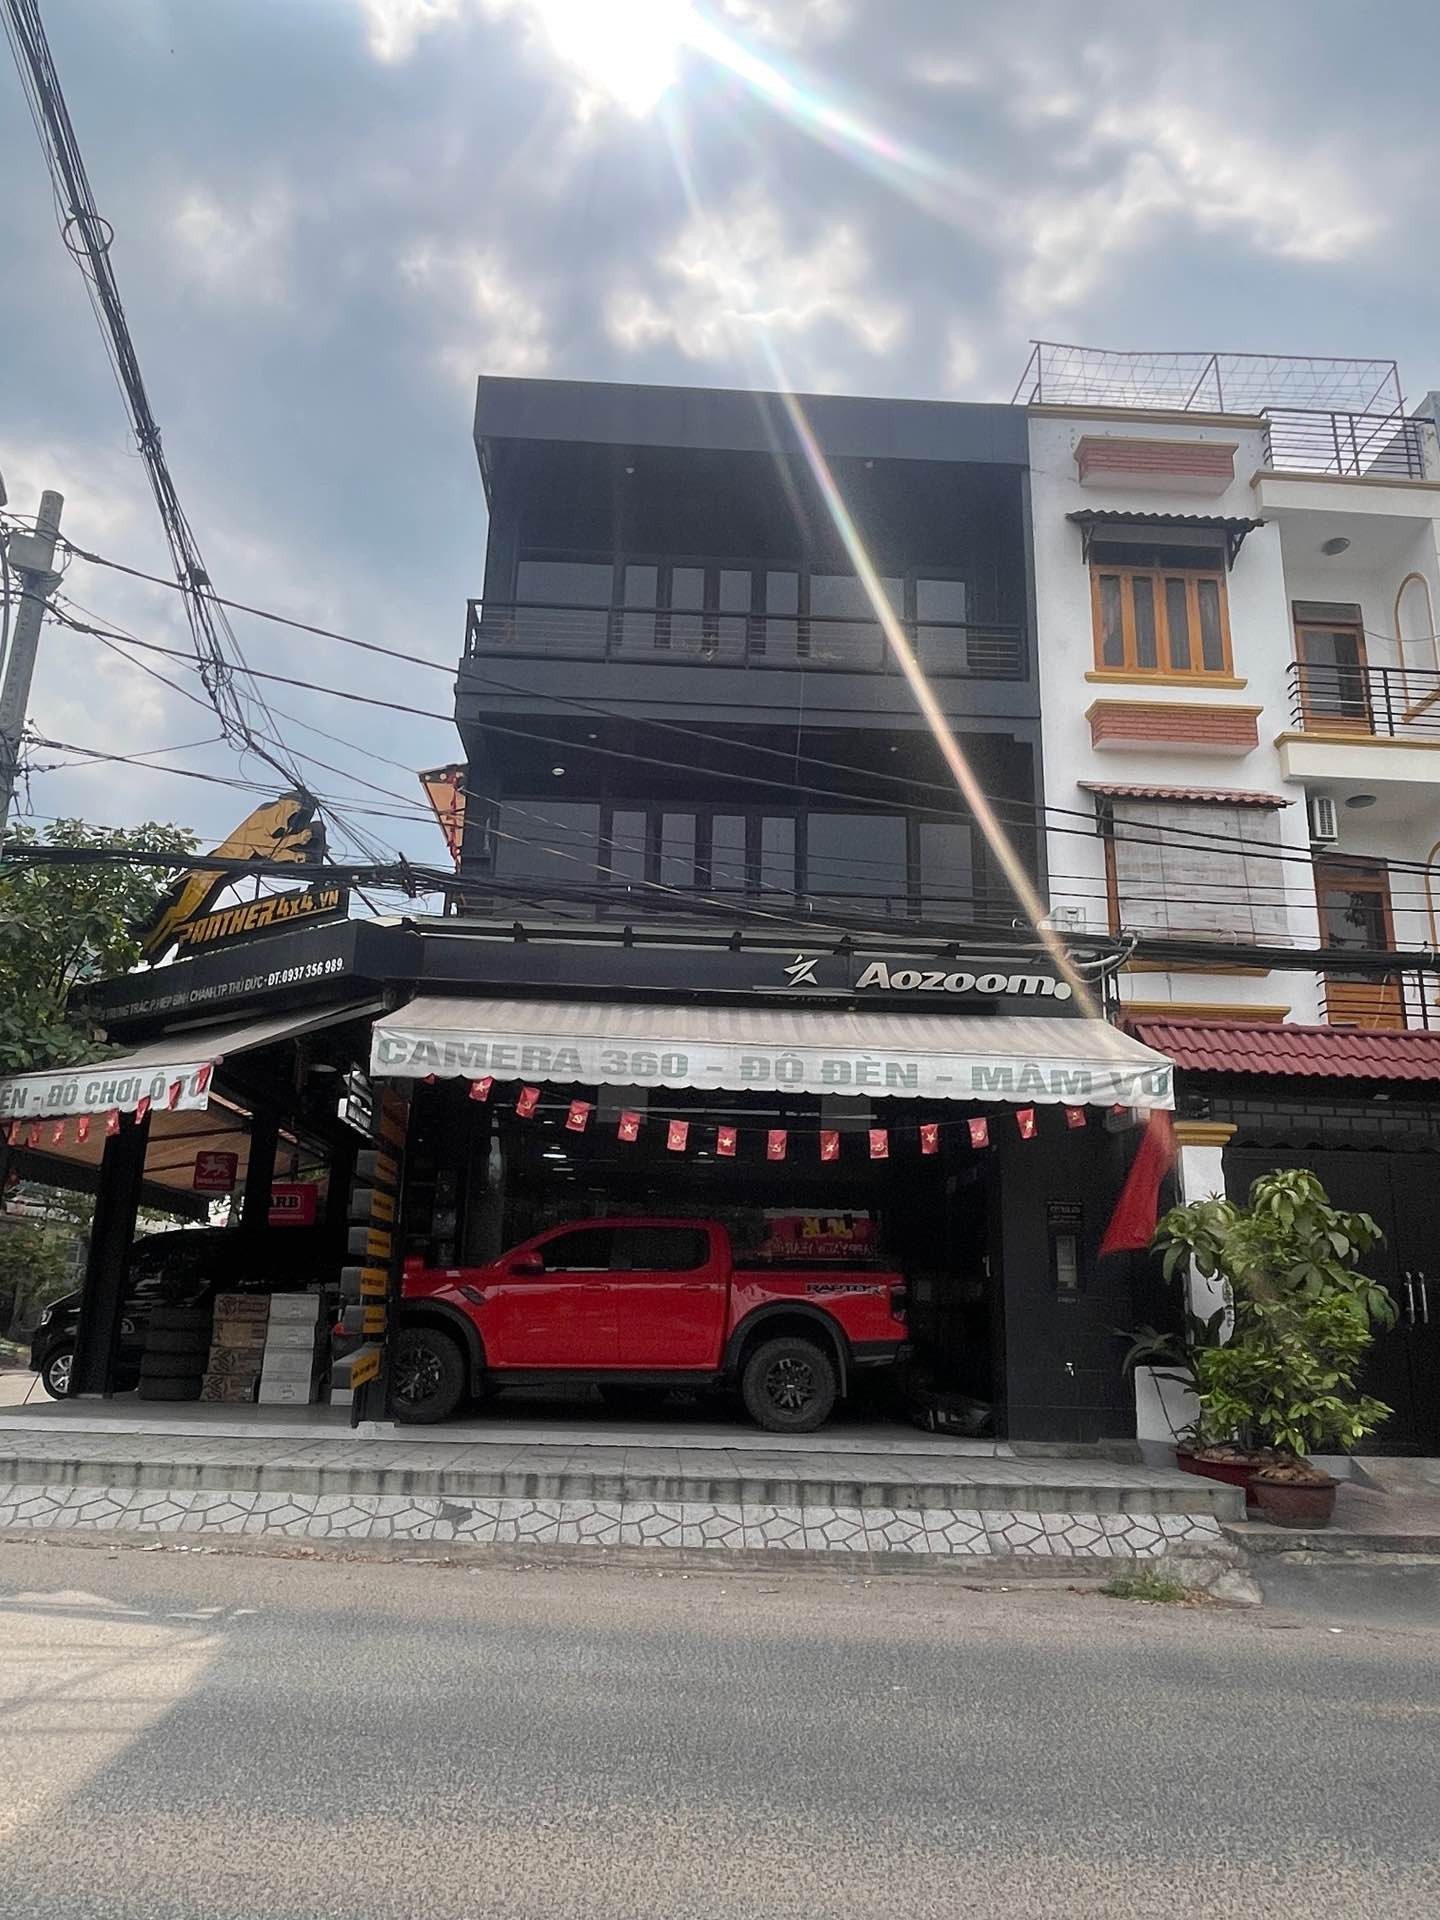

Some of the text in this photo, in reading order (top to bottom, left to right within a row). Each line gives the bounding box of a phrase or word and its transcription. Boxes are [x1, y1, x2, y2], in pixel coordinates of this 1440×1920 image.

[305, 961, 323, 978] 356
[377, 1038, 583, 1073] CAMERA
[600, 1049, 688, 1078] 360
[739, 1052, 804, 1088] ĐỘ
[820, 1055, 918, 1088] ĐÈN
[971, 1063, 1092, 1095] MÂM
[84, 1076, 142, 1105] CHƠI
[150, 1072, 166, 1101] Ô
[271, 1195, 299, 1208] RB
